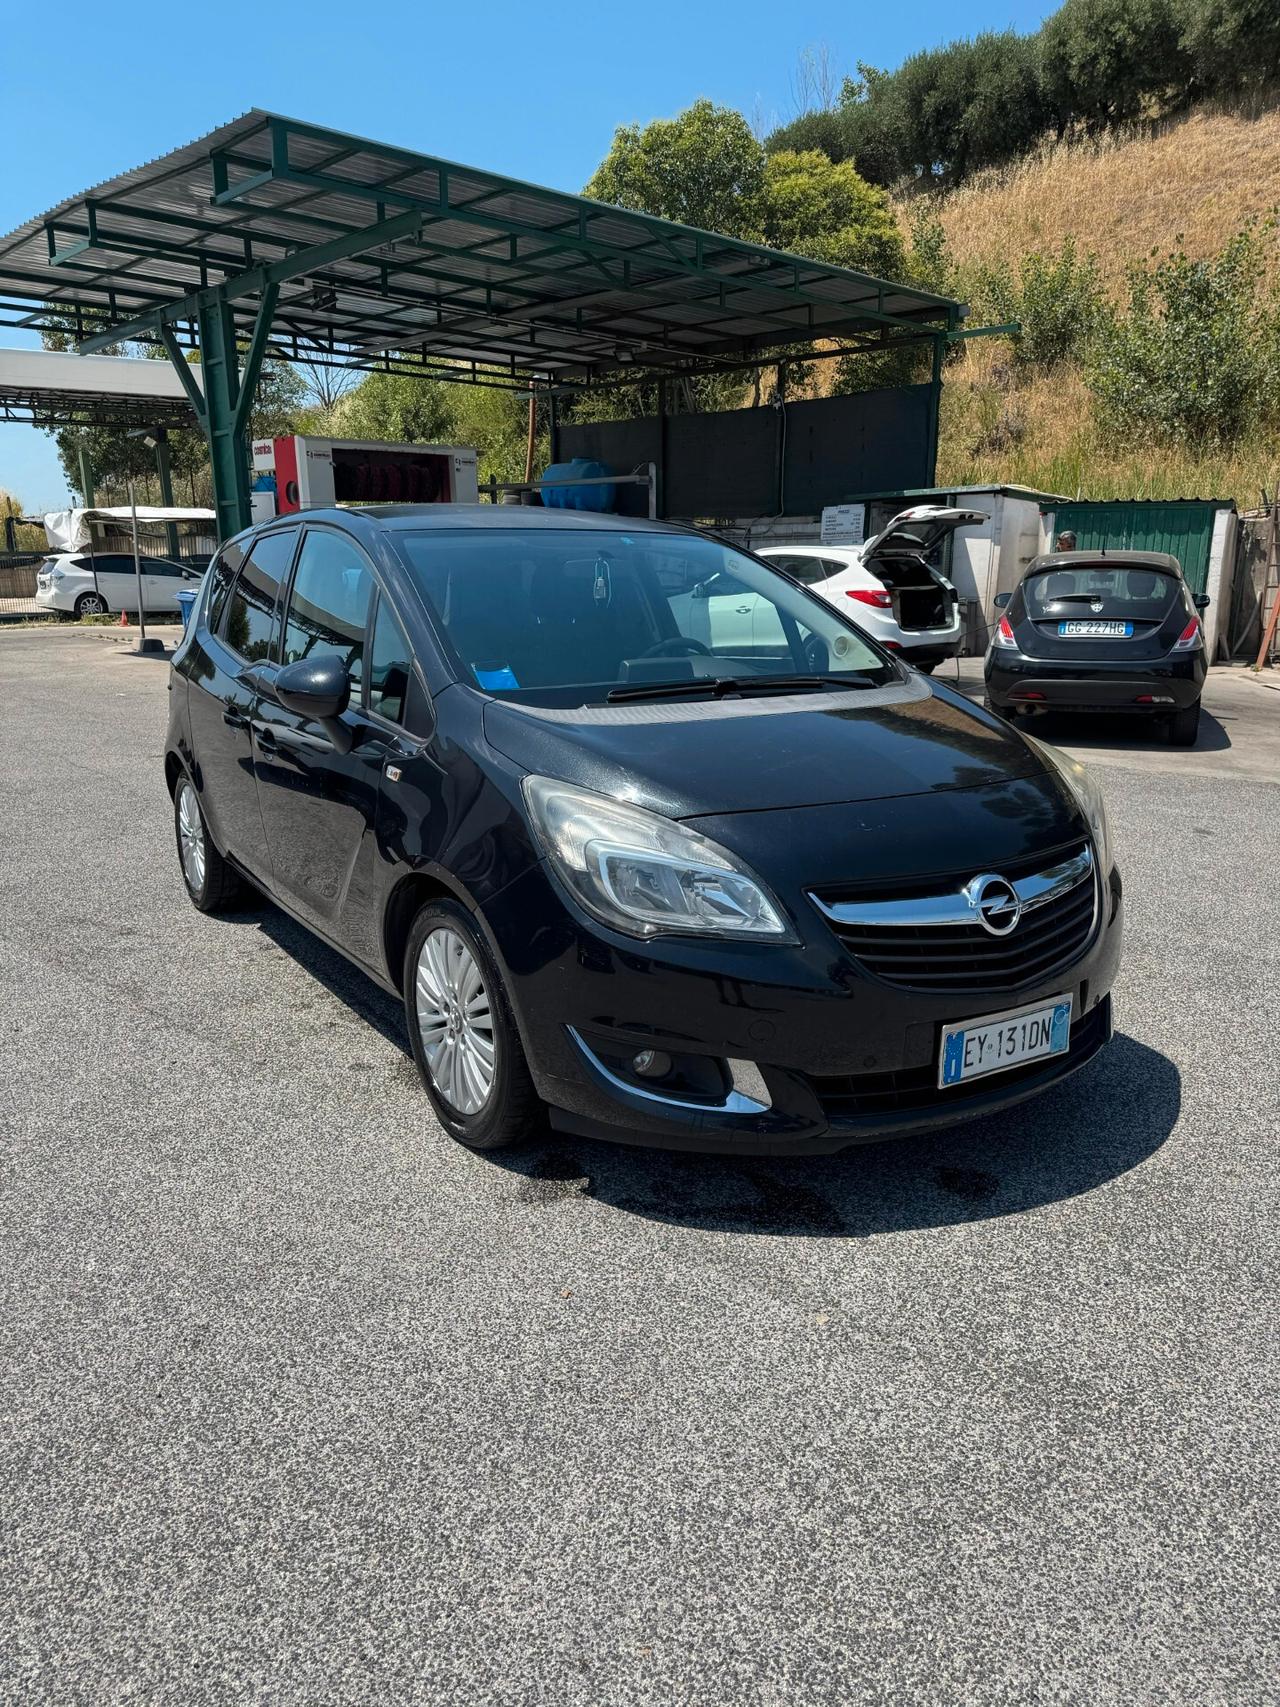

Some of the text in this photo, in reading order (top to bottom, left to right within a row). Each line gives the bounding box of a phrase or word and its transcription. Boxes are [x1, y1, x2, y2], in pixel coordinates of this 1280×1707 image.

[1067, 622, 1124, 634] GG 227HG
[964, 1017, 1051, 1068] EY 131DN
[951, 1059, 956, 1076] I
